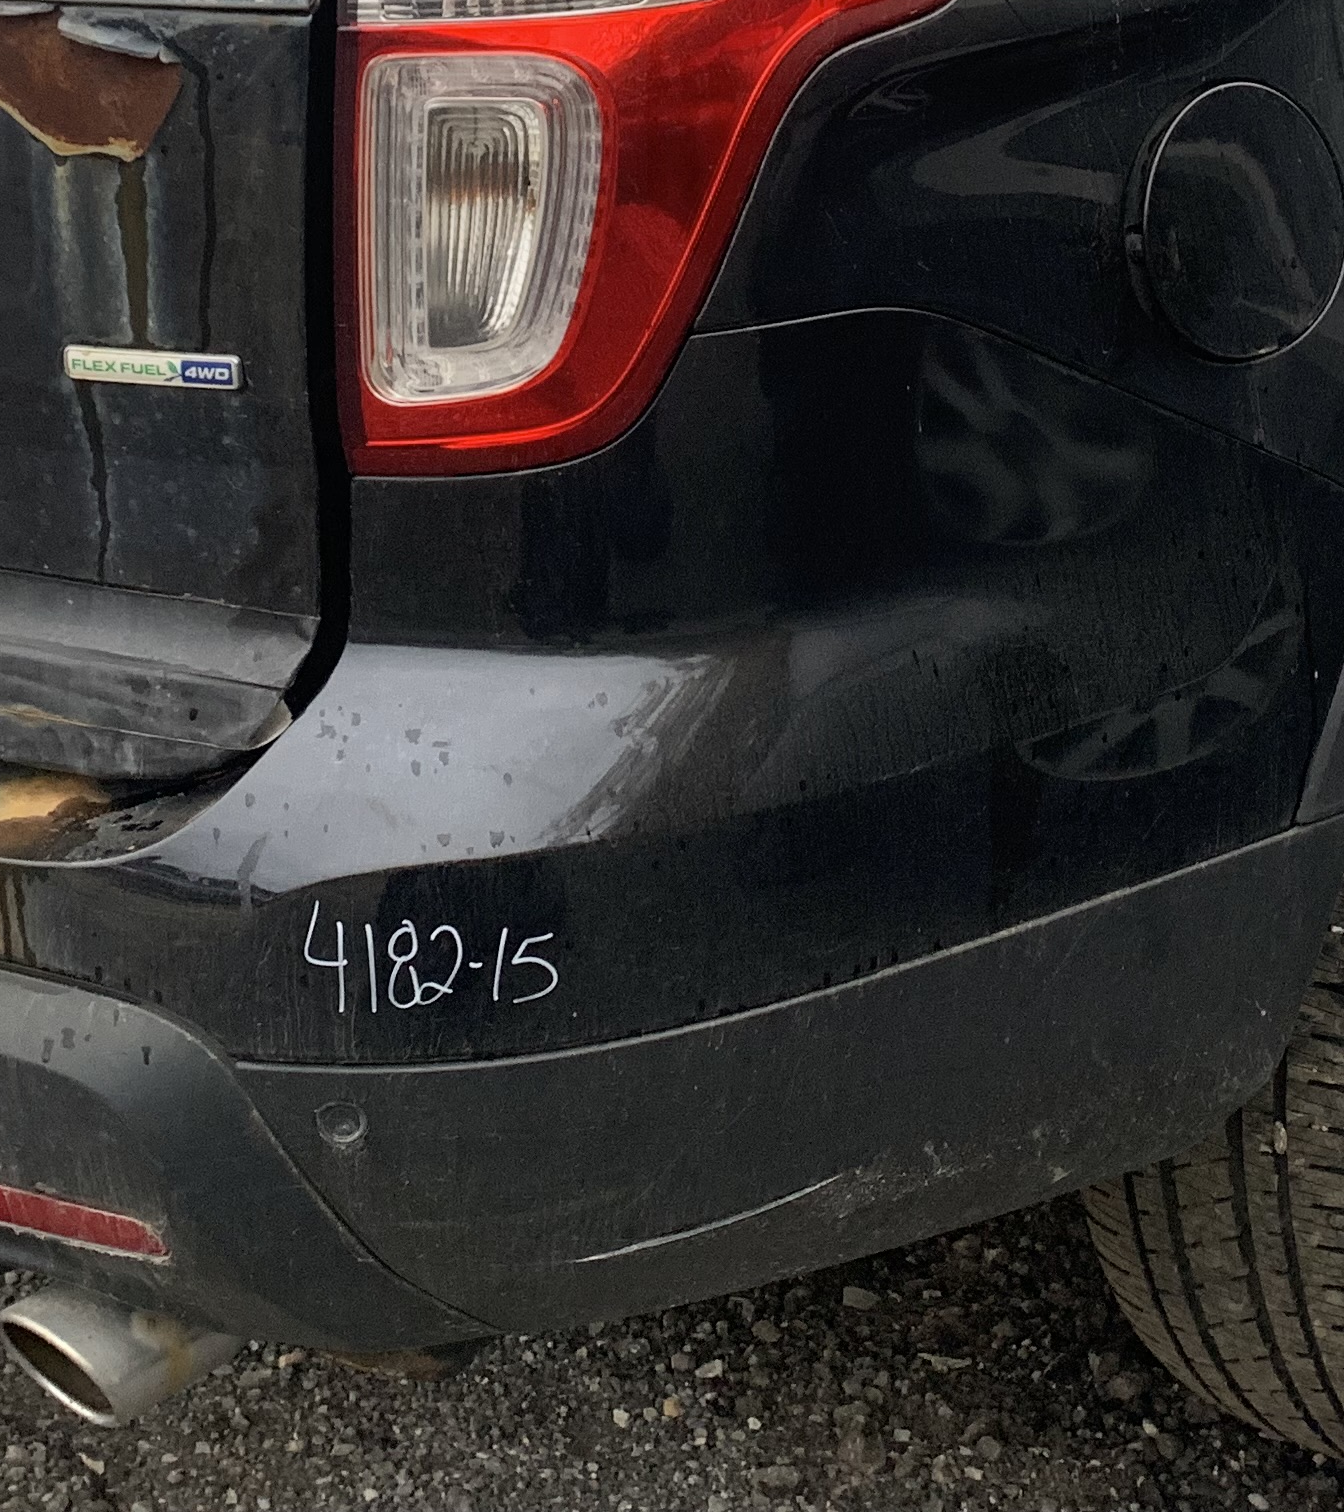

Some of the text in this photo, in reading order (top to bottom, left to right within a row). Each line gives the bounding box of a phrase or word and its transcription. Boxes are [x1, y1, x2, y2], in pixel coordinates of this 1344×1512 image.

[71, 357, 231, 381] FLEX FUEL 4WD
[304, 899, 558, 1014] 4182-15
